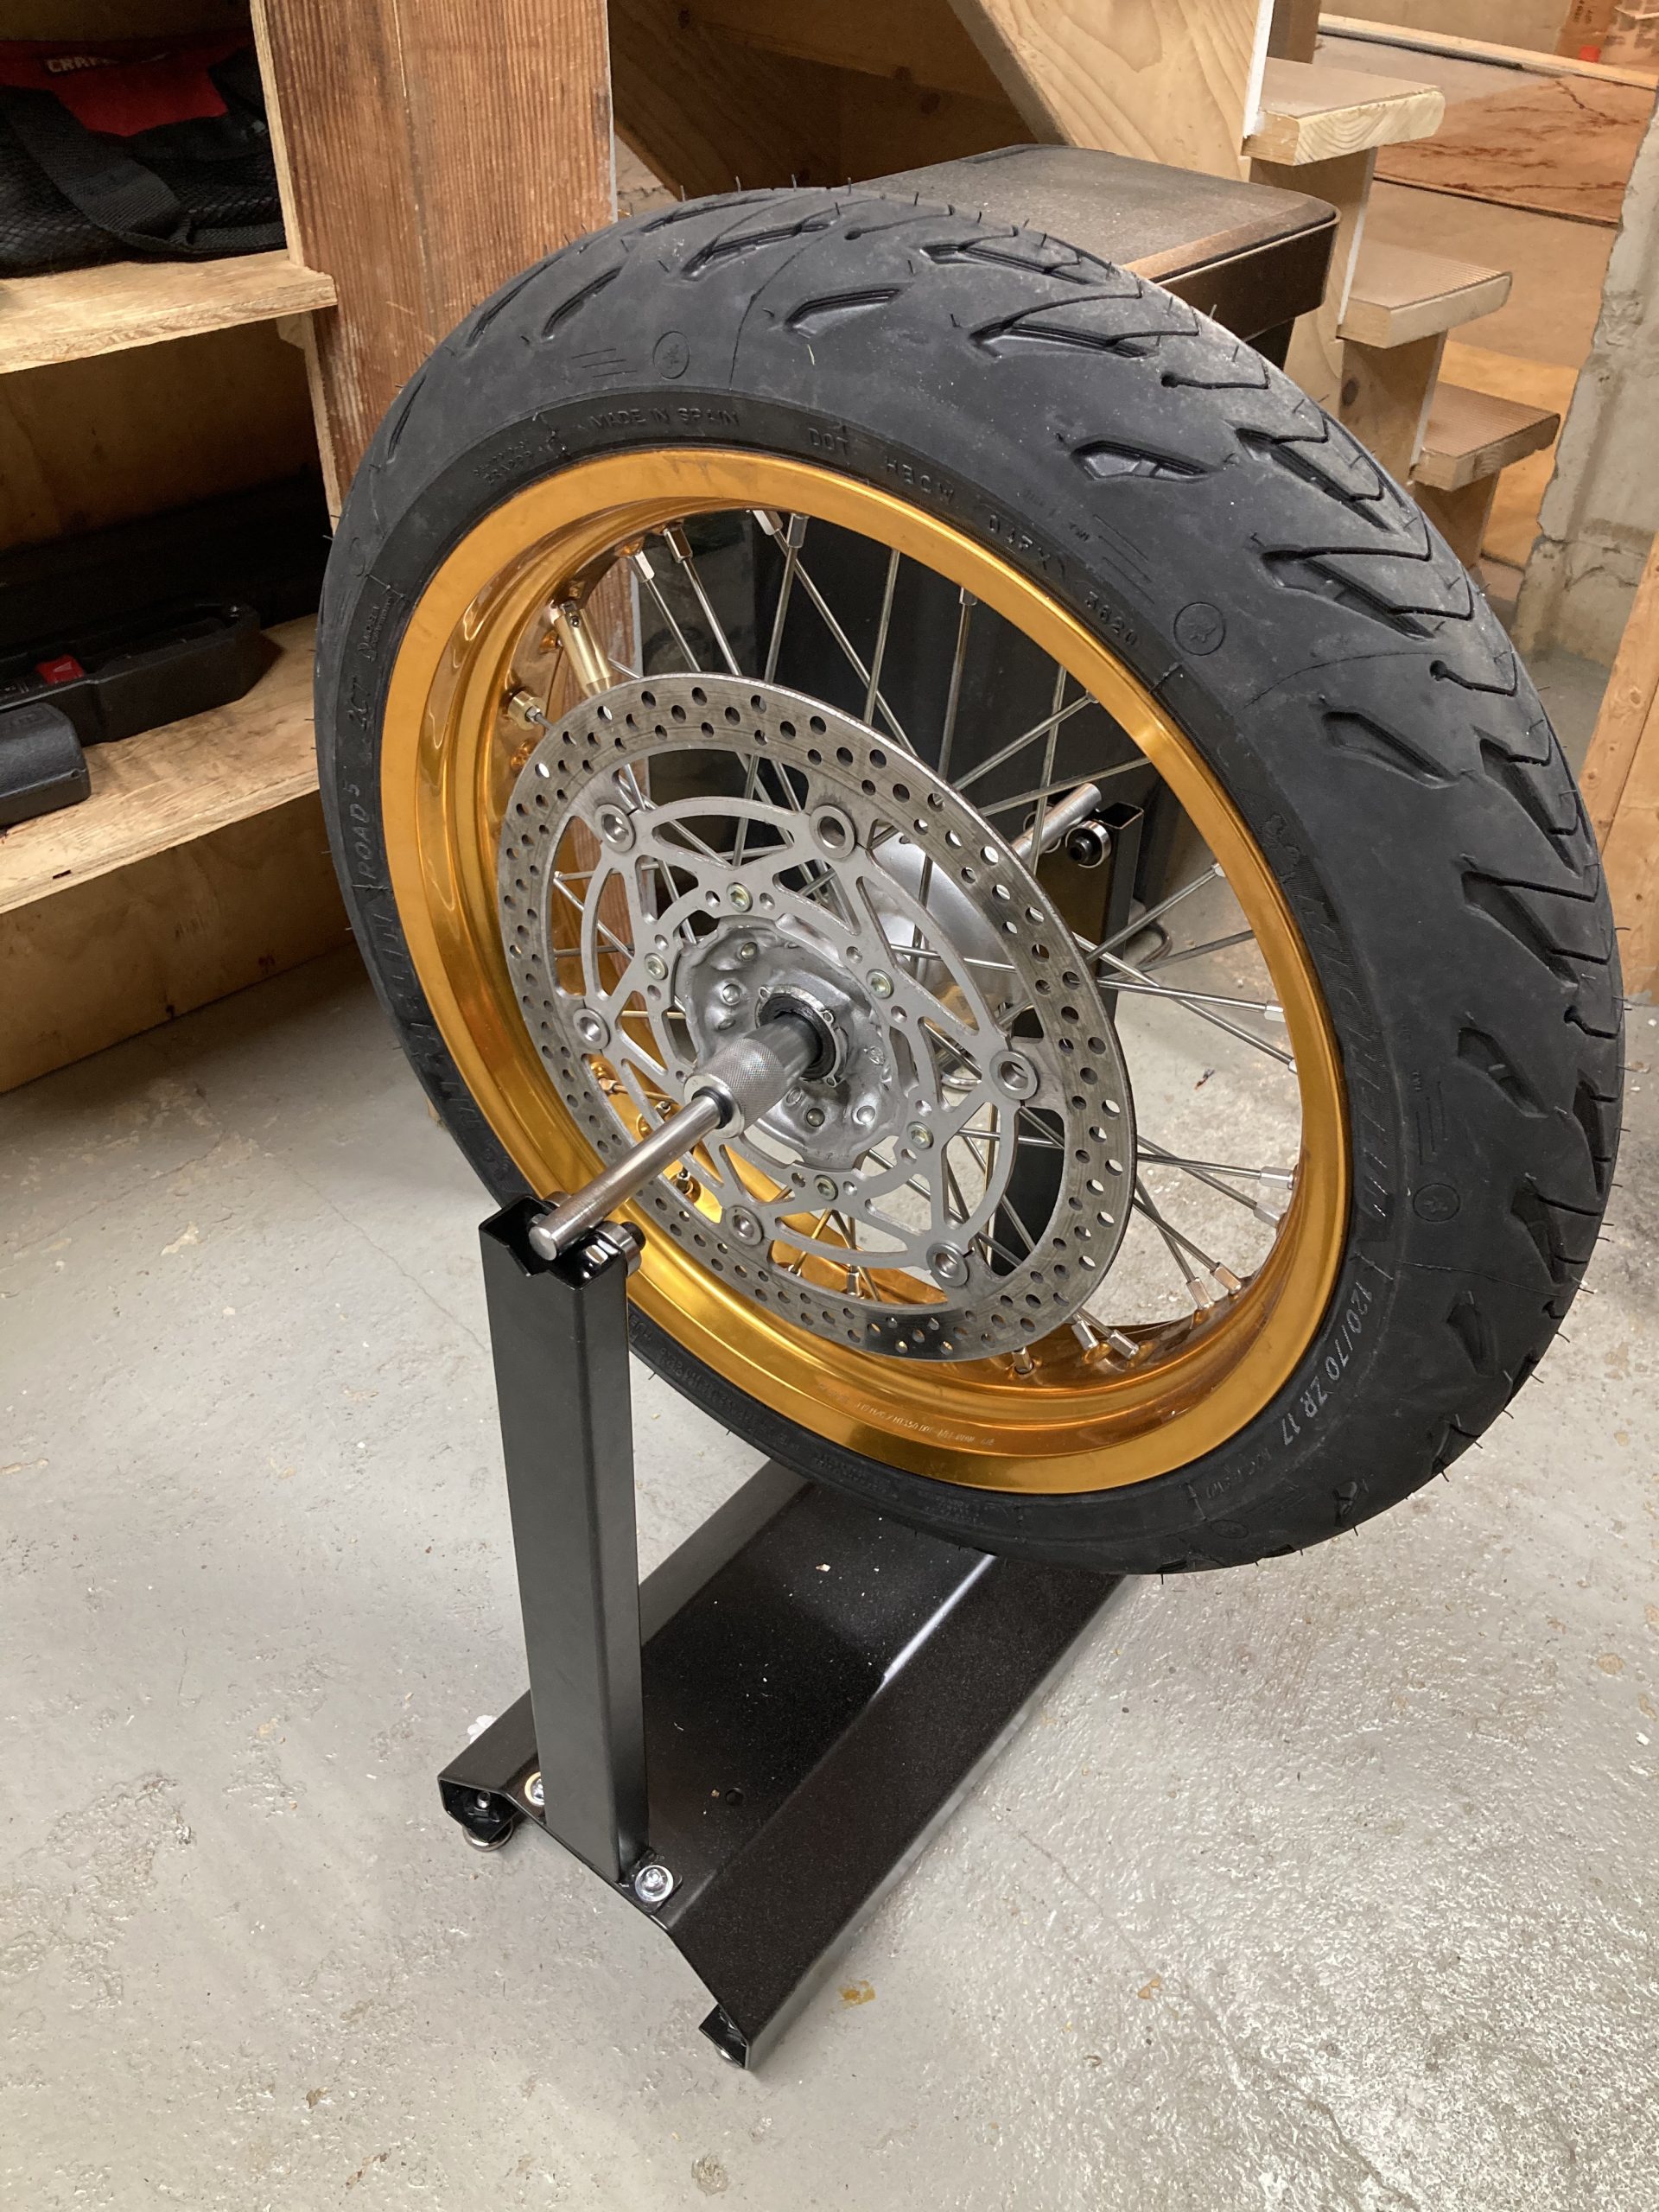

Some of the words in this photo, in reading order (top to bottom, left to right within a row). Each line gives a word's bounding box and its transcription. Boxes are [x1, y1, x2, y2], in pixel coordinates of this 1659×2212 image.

[588, 408, 646, 429] MADE
[650, 408, 670, 424] IN
[677, 407, 740, 426] SPAIN
[808, 426, 850, 456] DOT
[348, 803, 378, 880] ROAD
[1325, 1281, 1373, 1381] 120/70
[1300, 1376, 1328, 1418] ZR
[1281, 1413, 1301, 1446] 17
